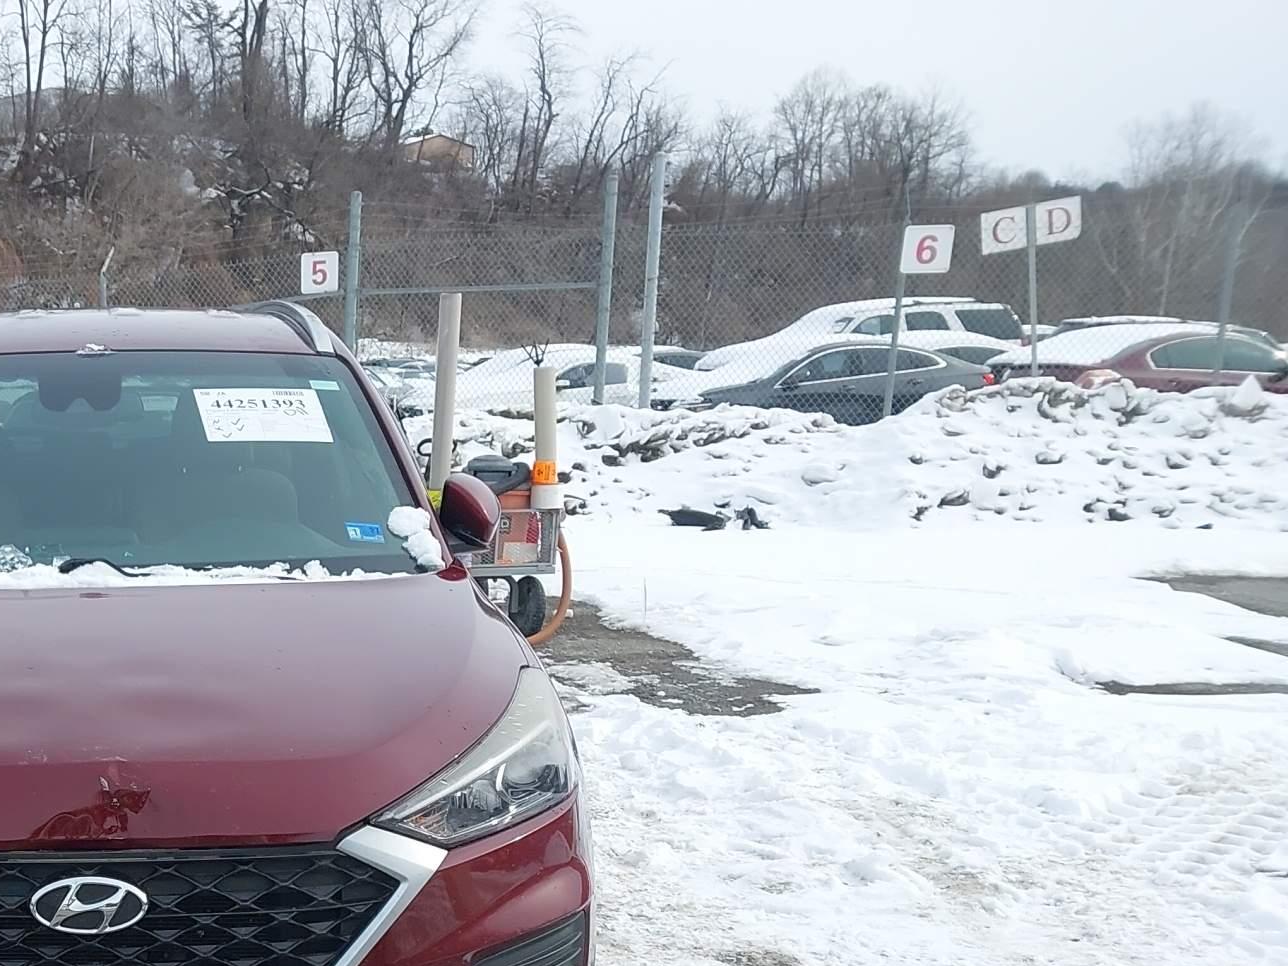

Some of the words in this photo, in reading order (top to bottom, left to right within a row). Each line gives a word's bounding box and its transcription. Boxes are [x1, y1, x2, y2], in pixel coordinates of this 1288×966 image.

[992, 216, 1017, 244] C
[1047, 207, 1071, 235] D
[915, 234, 939, 264] 6
[311, 260, 328, 286] 5
[210, 398, 306, 409] 44251393
